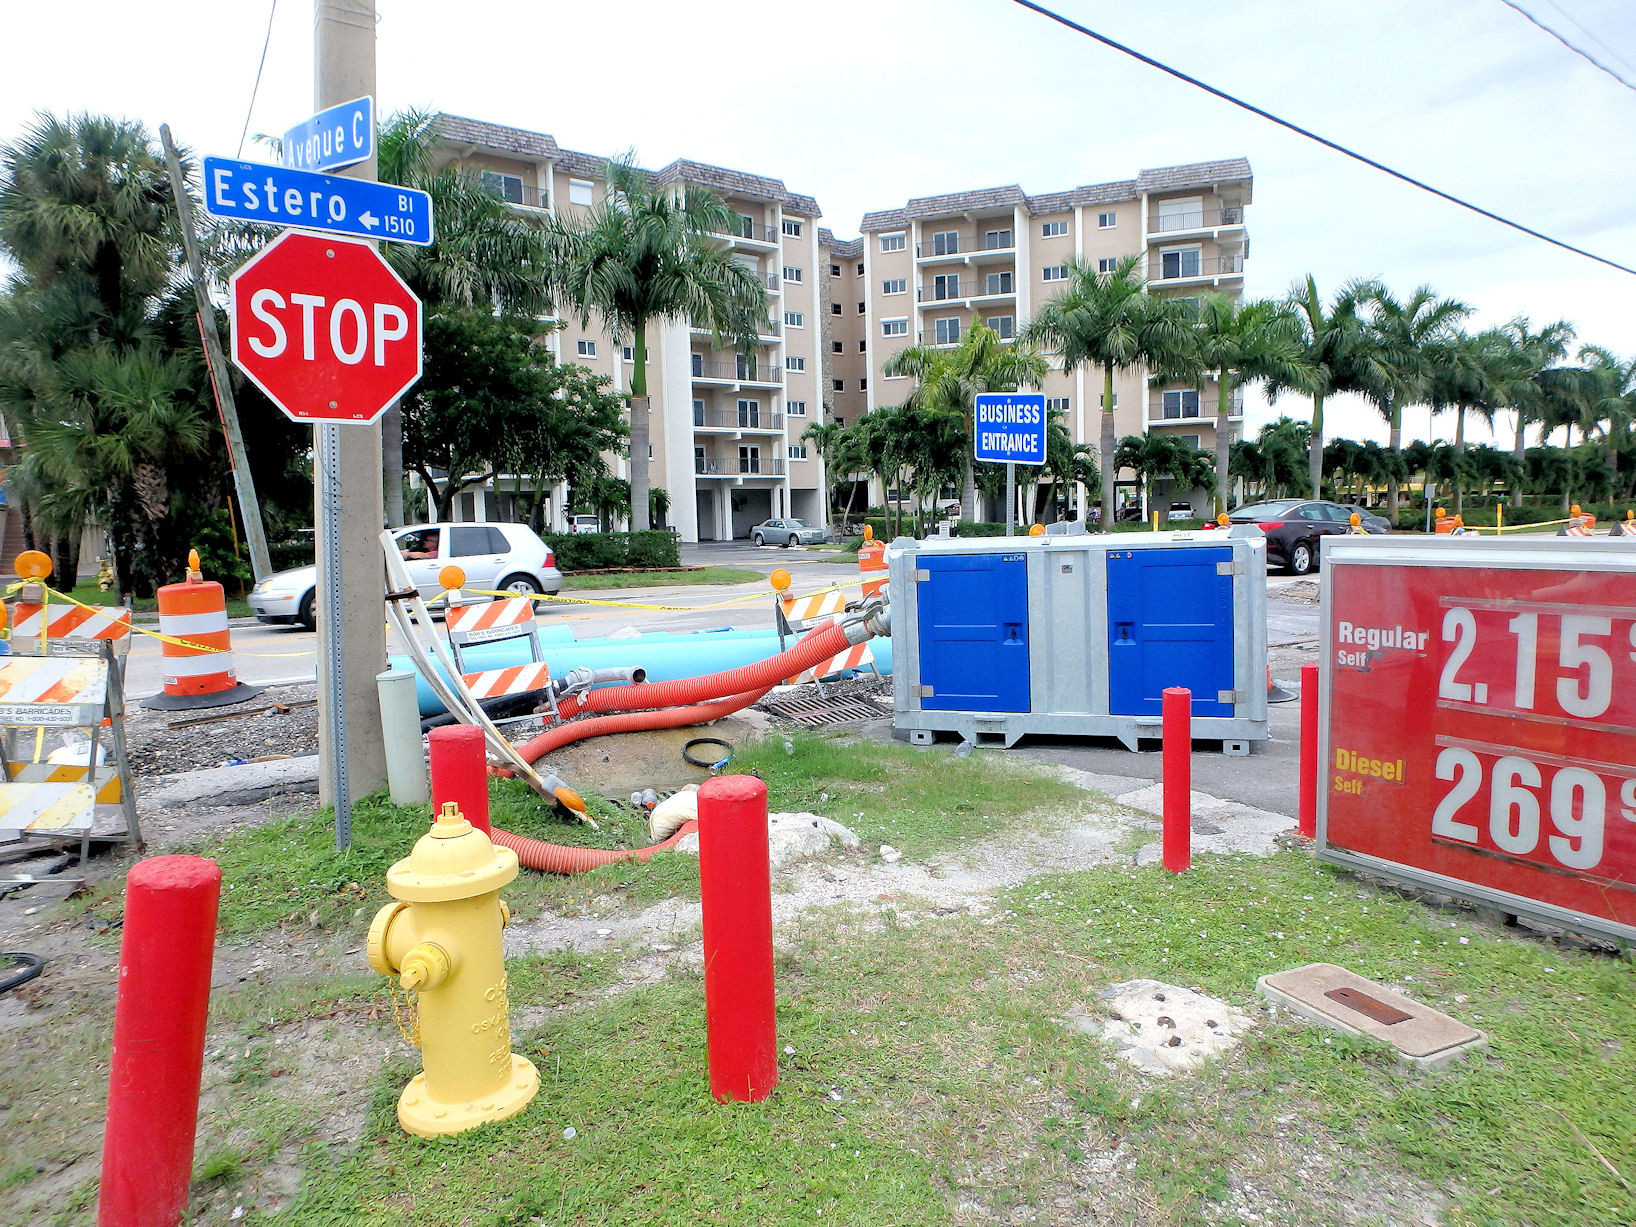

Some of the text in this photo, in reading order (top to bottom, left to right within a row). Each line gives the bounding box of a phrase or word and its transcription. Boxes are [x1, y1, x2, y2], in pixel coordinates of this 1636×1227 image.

[288, 110, 364, 167] Avenue C
[213, 168, 347, 222] Estero
[384, 215, 415, 236] 1510
[248, 288, 409, 367] STOP
[979, 403, 1040, 424] BUSINESS
[981, 431, 1038, 453] ENTRANCE
[1338, 621, 1428, 651] Regular
[1337, 650, 1367, 667] Self
[1336, 747, 1403, 781] Diesel
[1334, 775, 1363, 795] Self
[1431, 746, 1606, 870] 269
